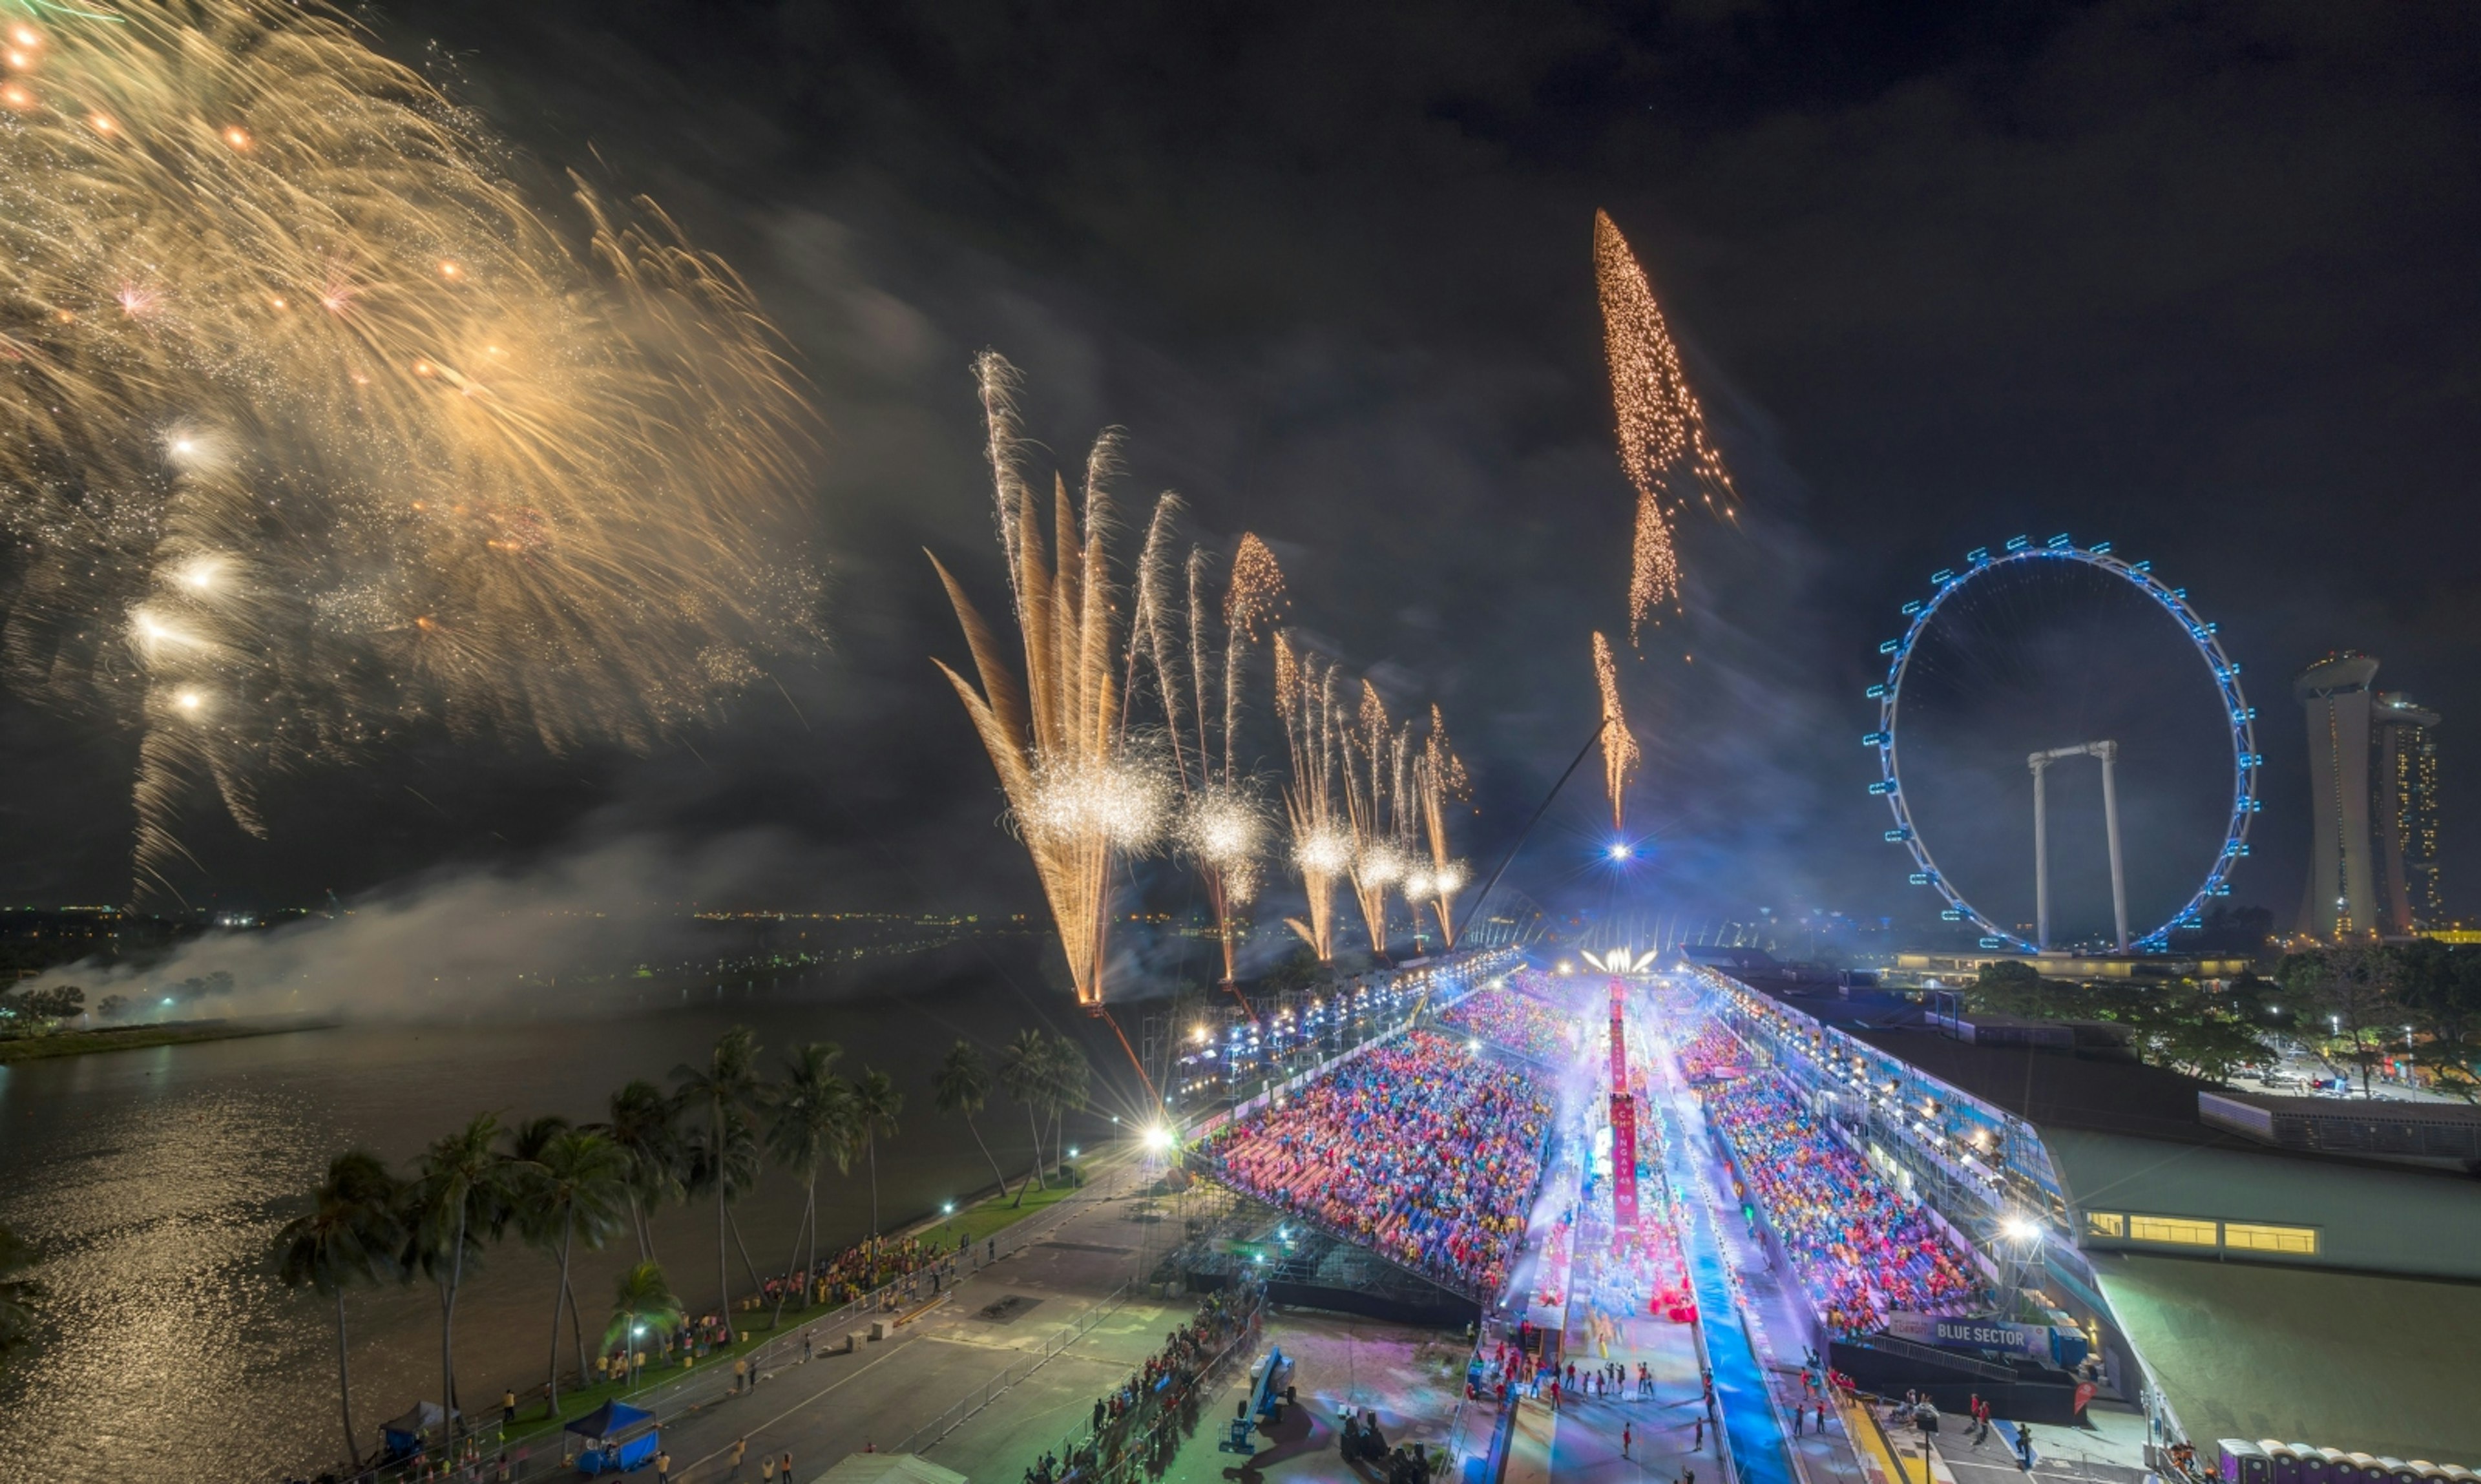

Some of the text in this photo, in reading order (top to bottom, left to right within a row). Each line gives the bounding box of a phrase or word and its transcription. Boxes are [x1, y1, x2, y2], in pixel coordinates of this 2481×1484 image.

[1618, 1111, 1628, 1175] CHINGAY
[1938, 1324, 1971, 1341] BLUE
[1973, 1327, 2025, 1346] SECTOR
